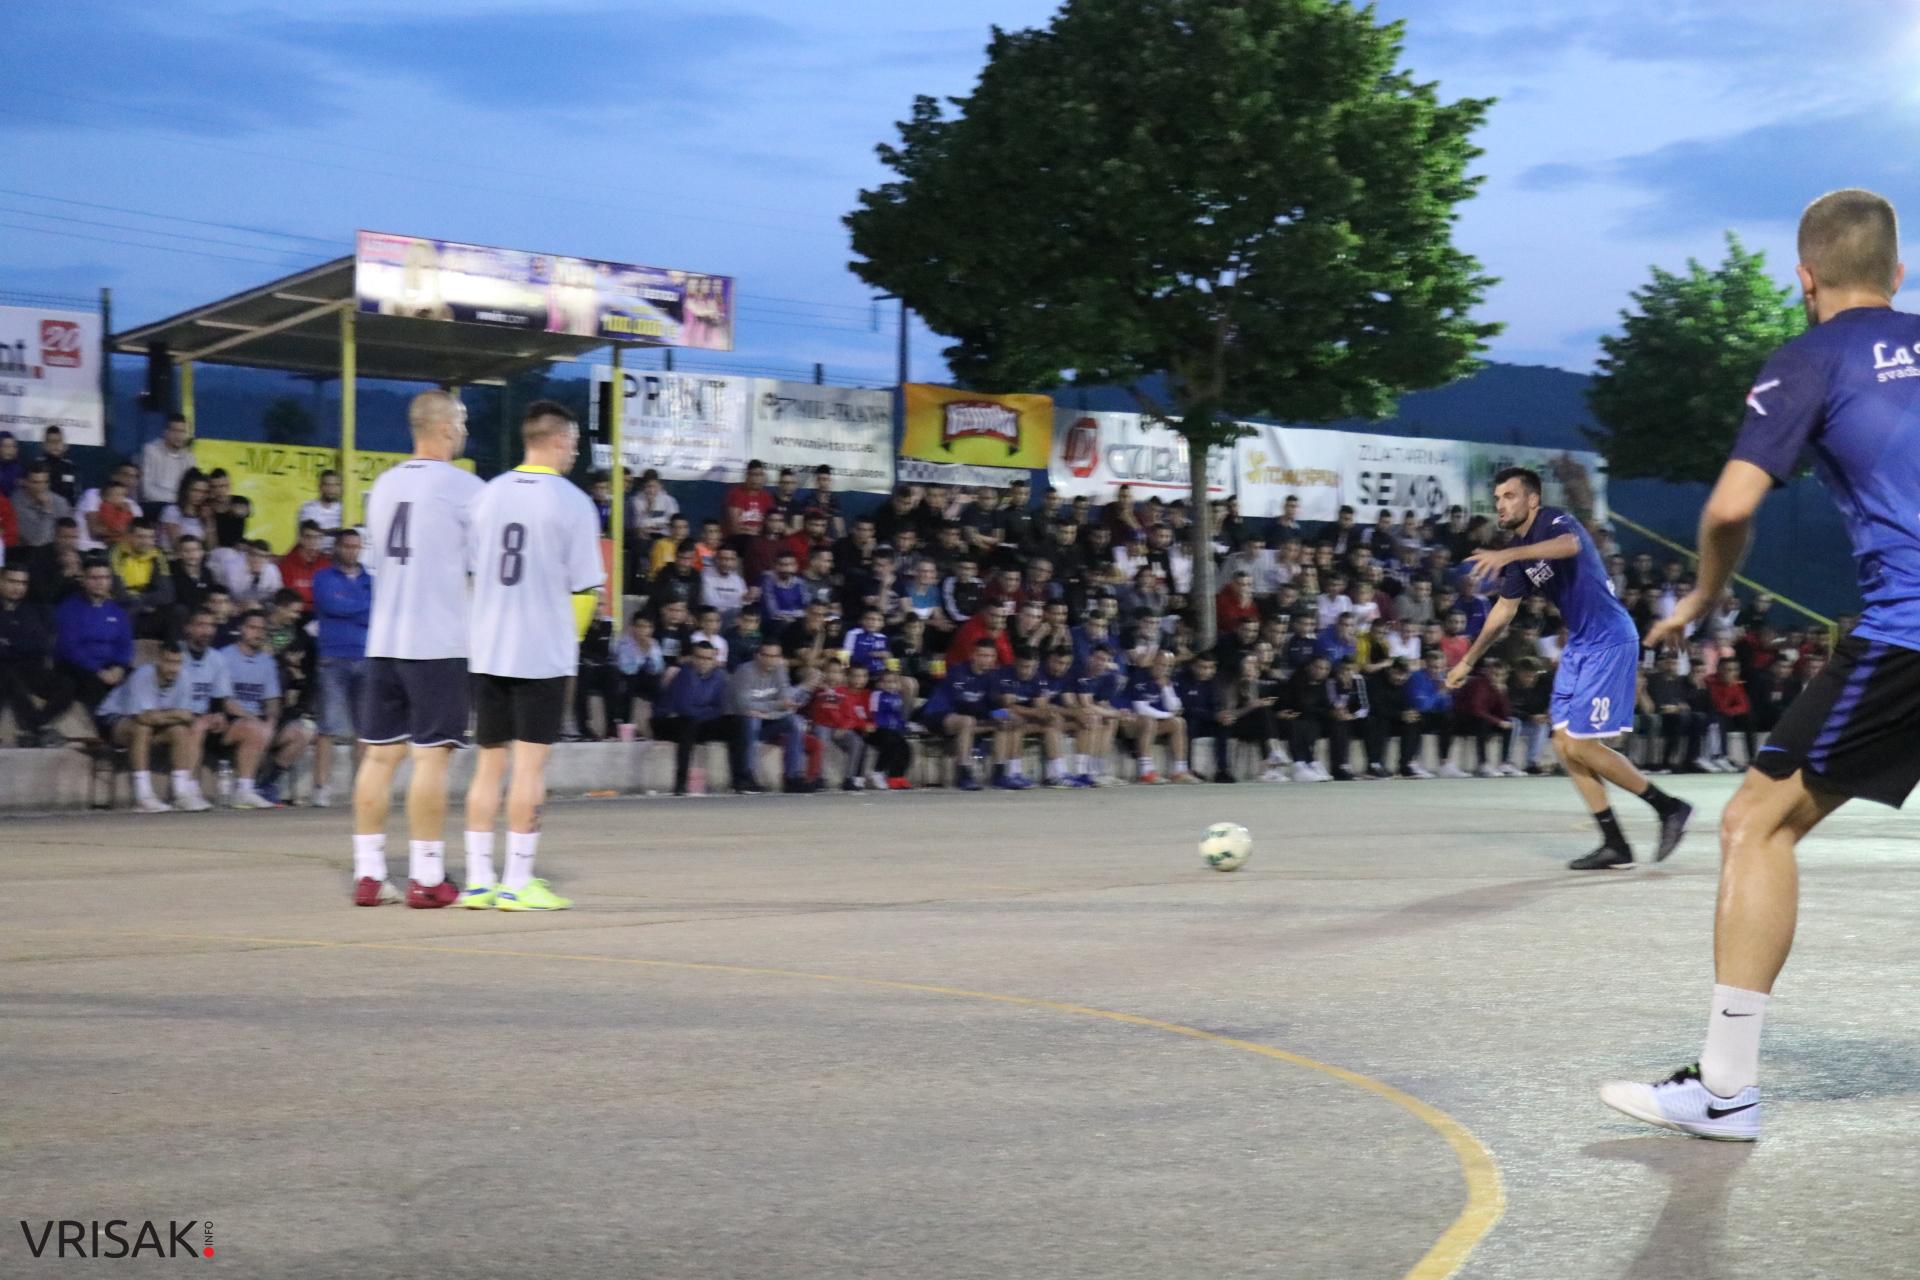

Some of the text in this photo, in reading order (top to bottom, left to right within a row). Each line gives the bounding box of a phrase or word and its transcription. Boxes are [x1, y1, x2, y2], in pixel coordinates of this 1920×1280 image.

[385, 501, 414, 566] 4
[500, 522, 526, 587] 8
[1589, 697, 1611, 722] 28
